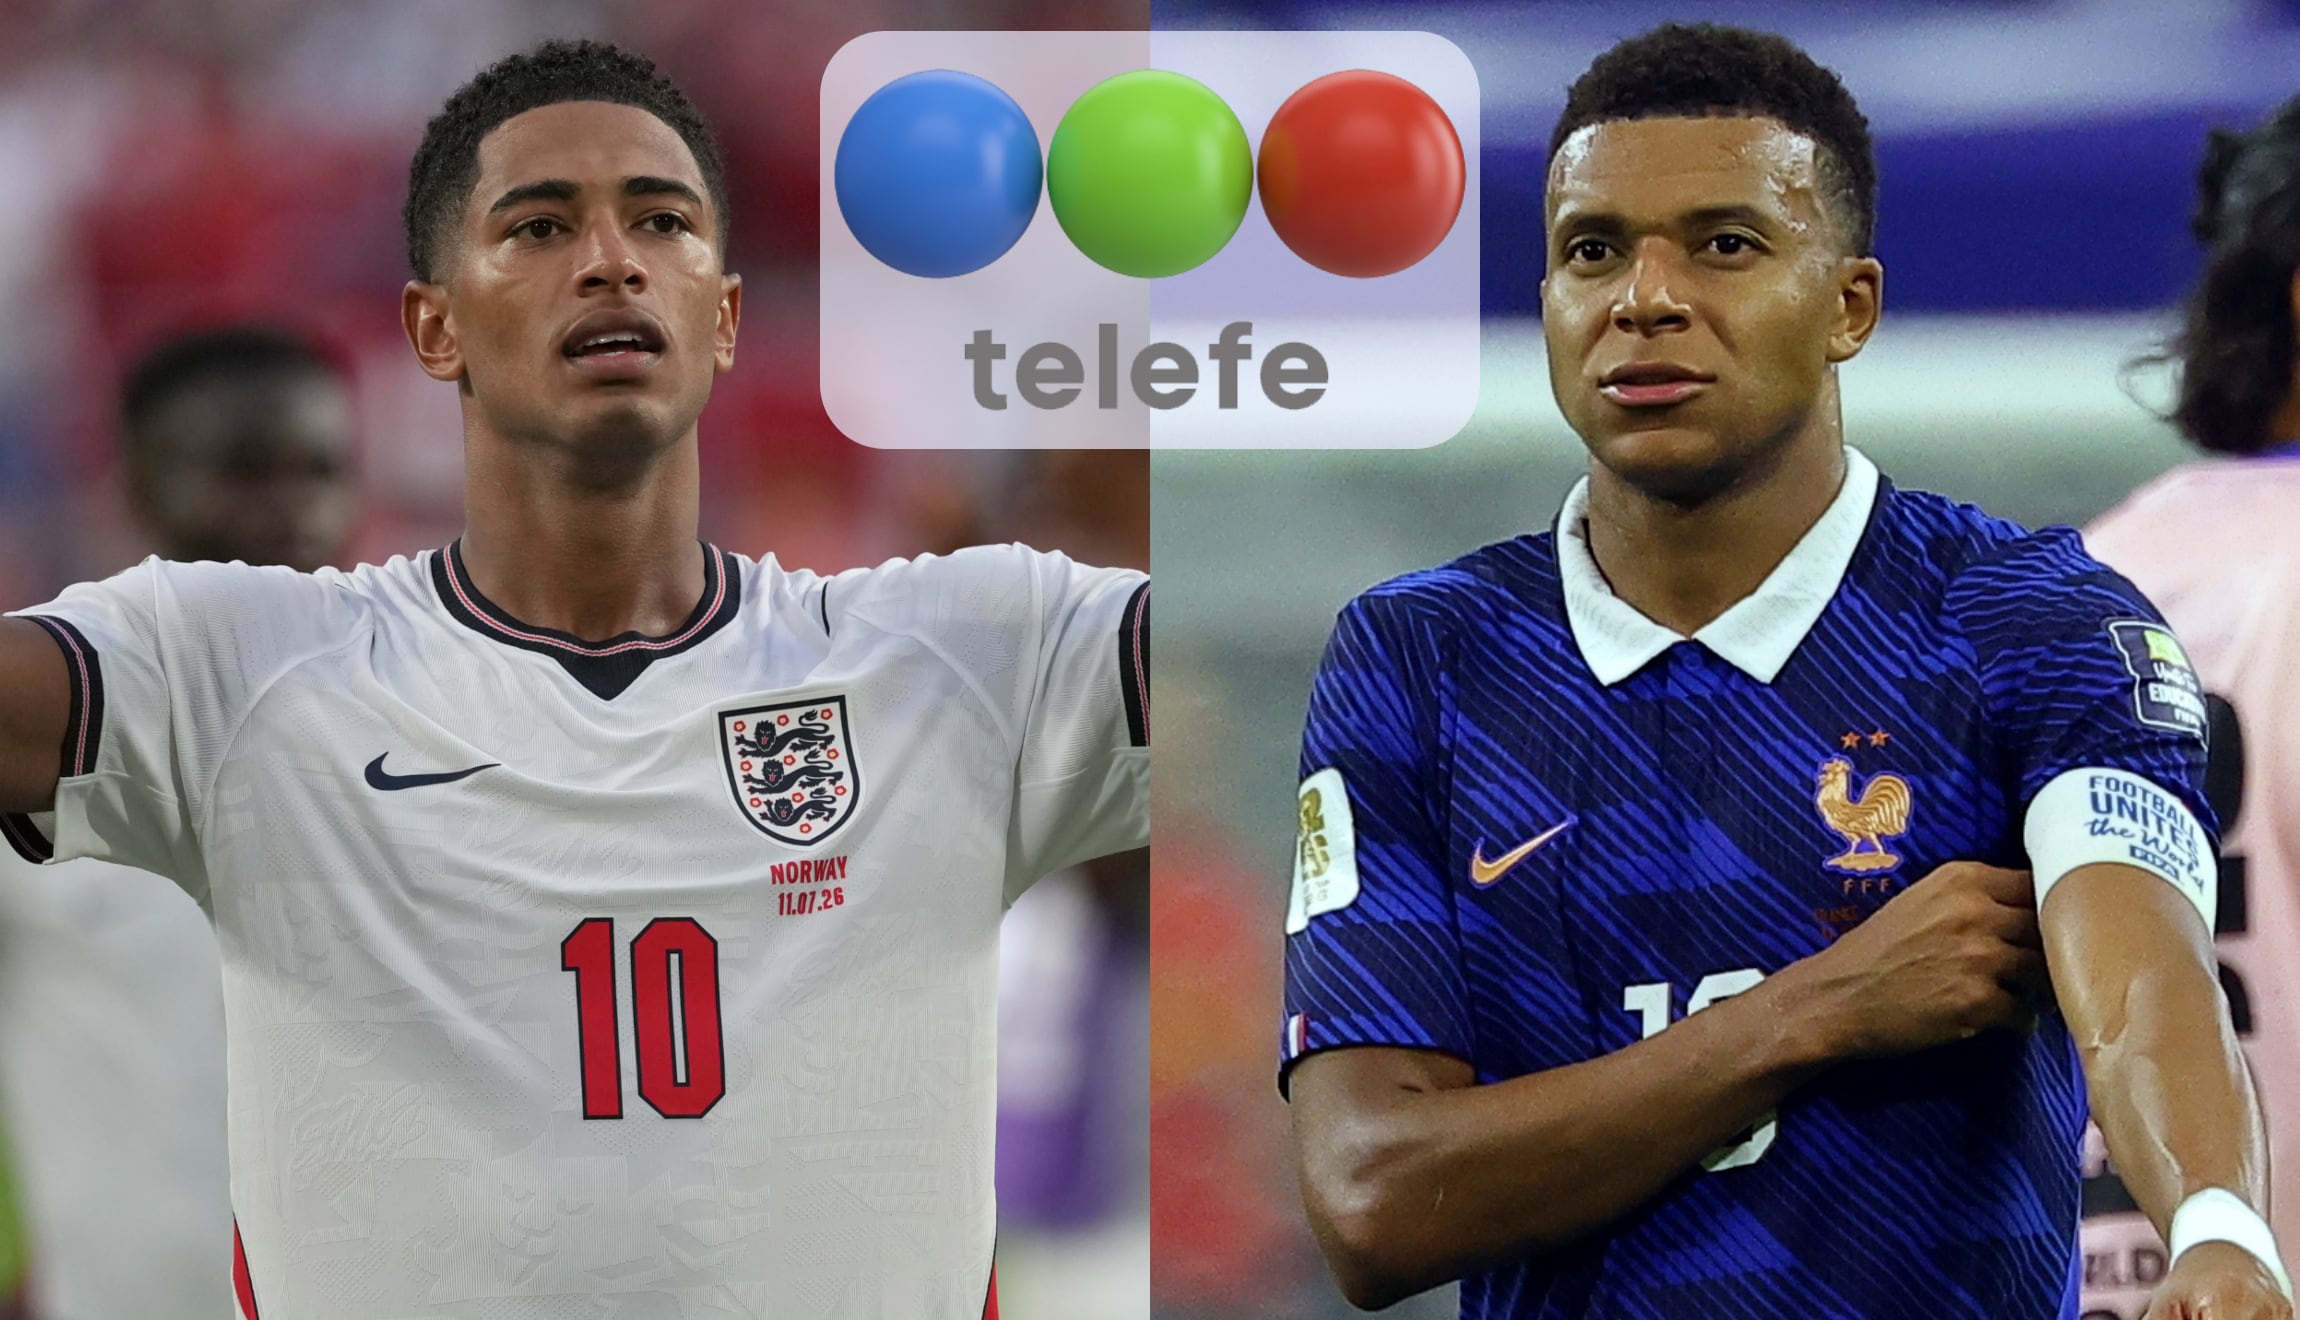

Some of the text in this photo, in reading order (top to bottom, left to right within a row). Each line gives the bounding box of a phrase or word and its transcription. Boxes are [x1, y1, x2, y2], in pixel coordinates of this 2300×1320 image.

[2089, 775, 2194, 841] FOOTBALL
[2090, 791, 2200, 867] UNITES
[770, 856, 848, 885] NORWAY
[2084, 817, 2205, 895] the World
[778, 887, 845, 916] 11.07.26
[561, 917, 726, 1119] 10
